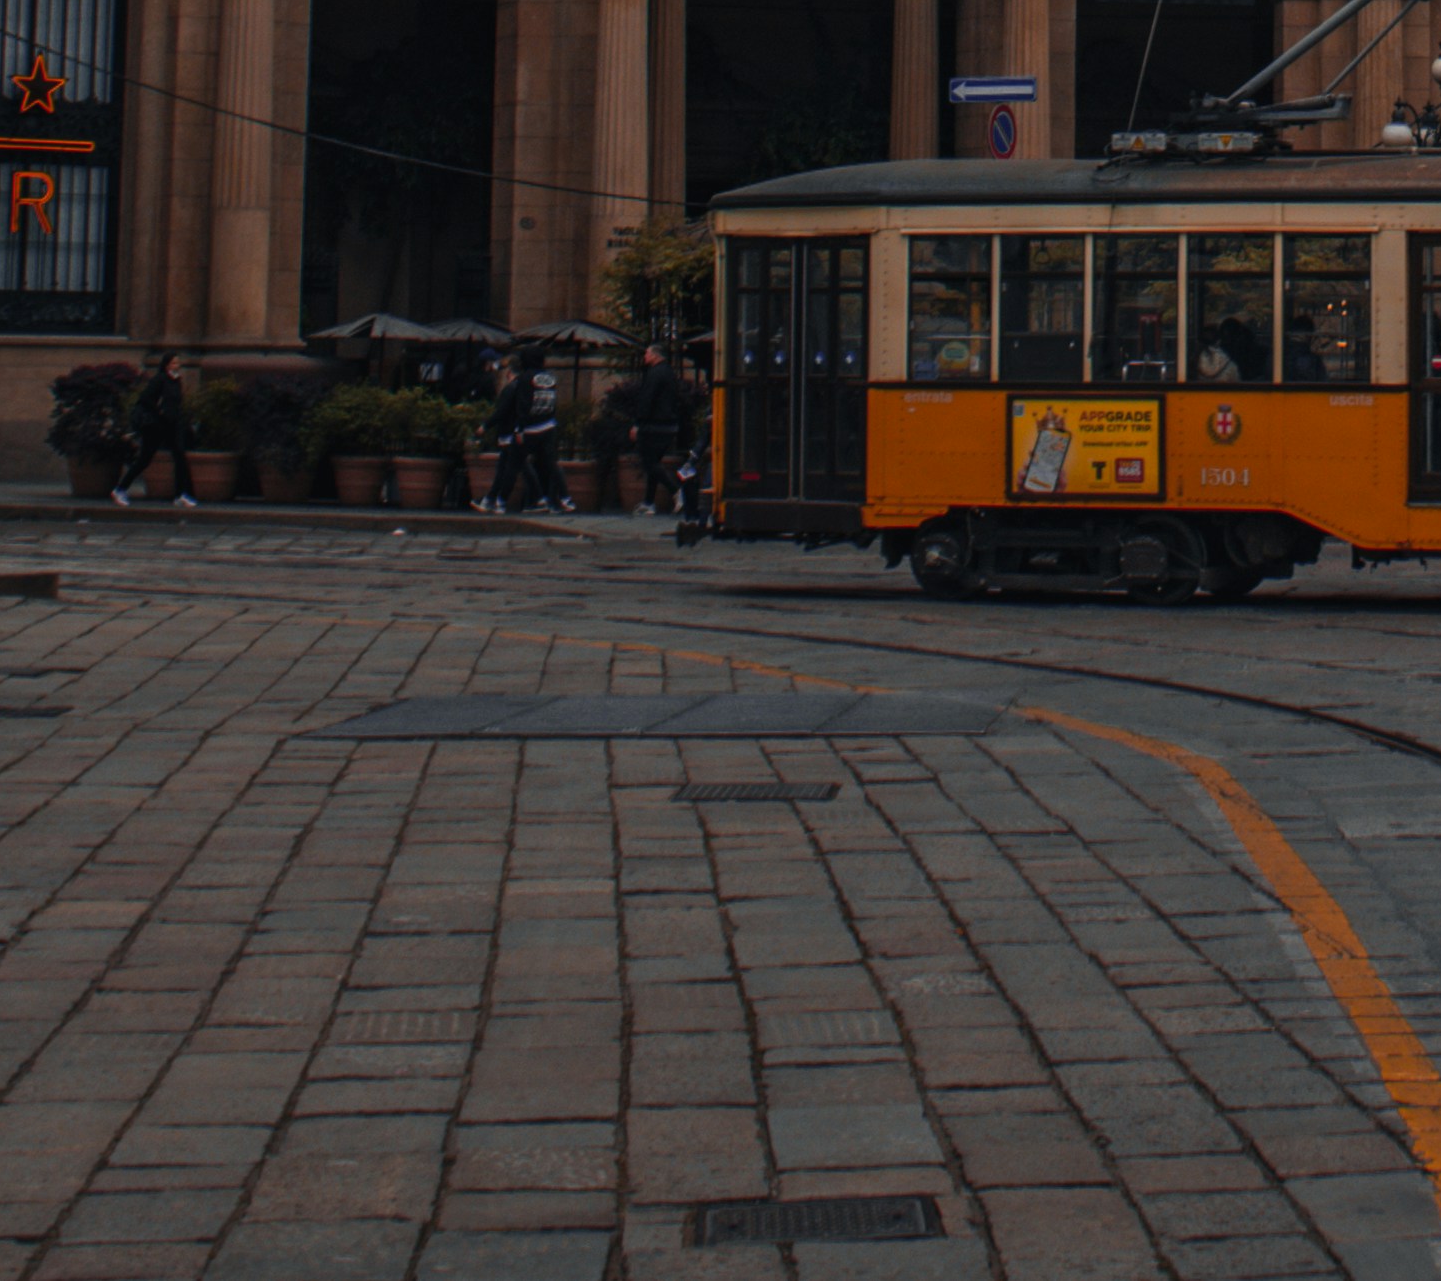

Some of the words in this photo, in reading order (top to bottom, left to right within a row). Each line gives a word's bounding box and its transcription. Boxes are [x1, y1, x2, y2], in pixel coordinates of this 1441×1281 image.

[1328, 394, 1375, 407] uscita
[1079, 410, 1153, 423] APPGRADE
[1078, 424, 1105, 432] YOUR
[1108, 424, 1128, 432] CITY
[1199, 466, 1251, 486] 1504
